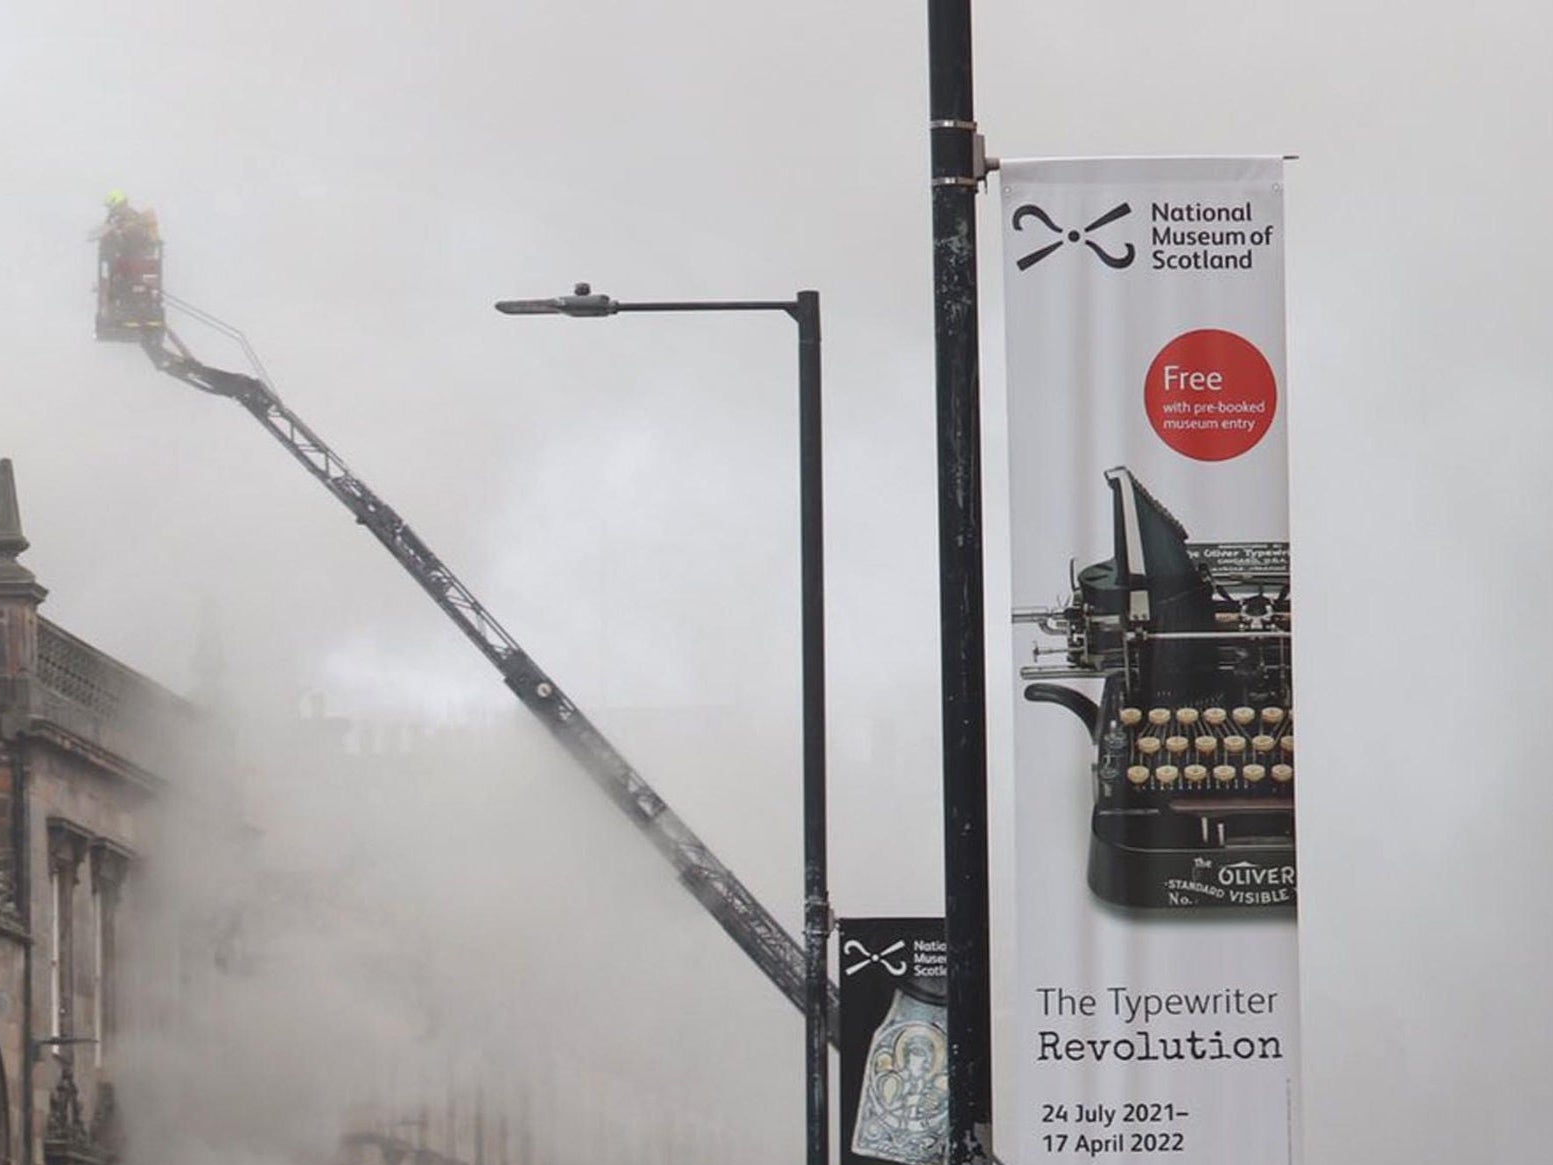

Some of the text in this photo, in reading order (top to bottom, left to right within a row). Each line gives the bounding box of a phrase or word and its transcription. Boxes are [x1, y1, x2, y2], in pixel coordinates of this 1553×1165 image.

[1151, 202, 1252, 222] National
[1152, 225, 1274, 246] Museum of
[1152, 250, 1253, 270] Scotland
[1163, 366, 1224, 390] Free
[1163, 401, 1265, 416] with pre-booked
[1163, 418, 1256, 432] museum entry
[1218, 866, 1295, 885] OLIVER
[1229, 888, 1290, 904] VISIBLE
[914, 940, 947, 951] Natio
[1036, 987, 1278, 1023] The Typewriter
[1037, 1031, 1283, 1061] Revolution
[1042, 1103, 1189, 1127] 24 July 2021–
[1043, 1133, 1184, 1156] 17 April 2022
